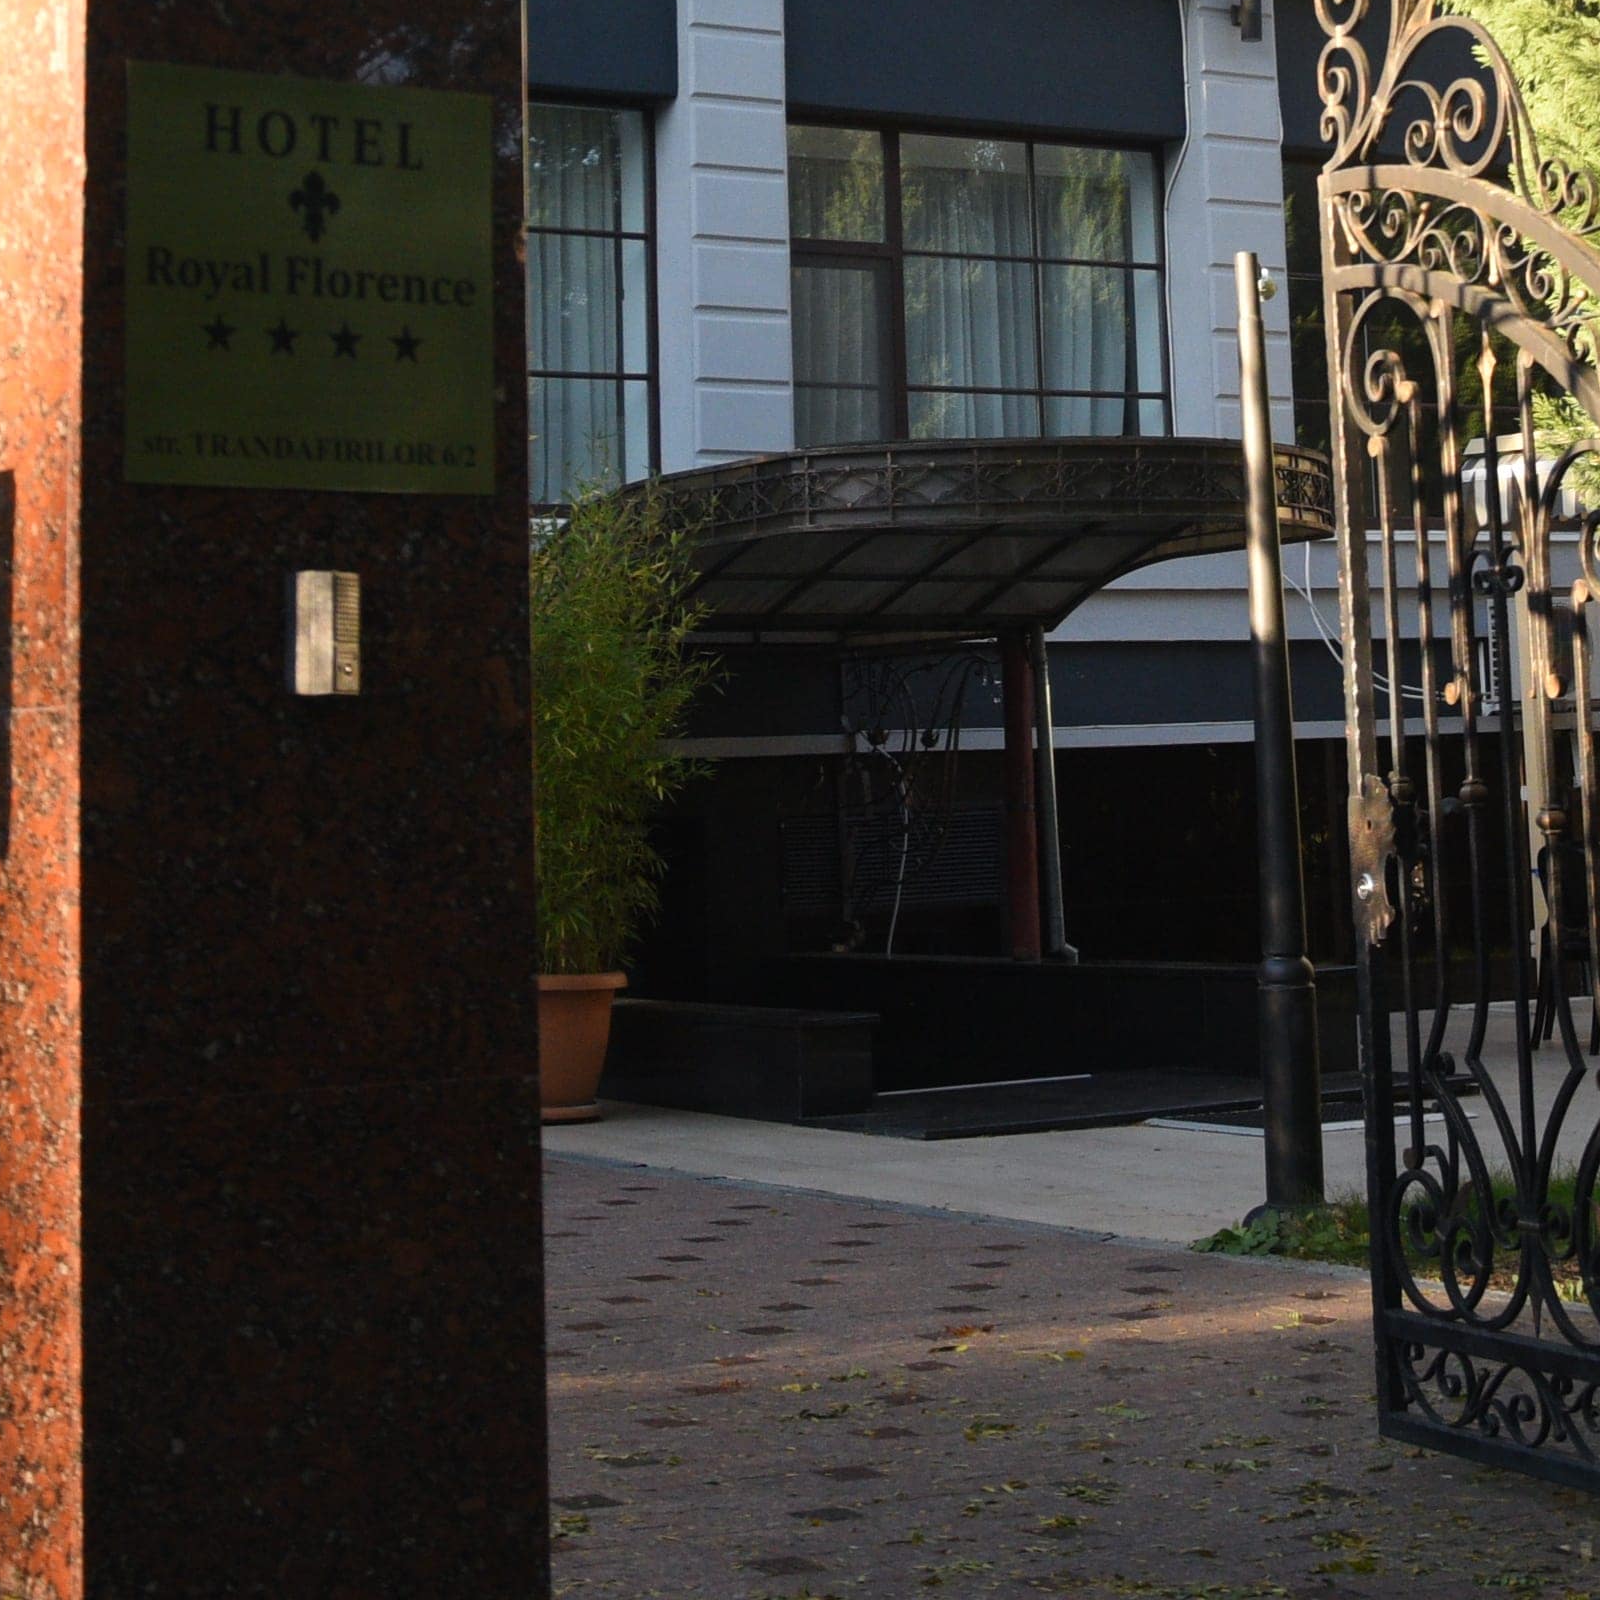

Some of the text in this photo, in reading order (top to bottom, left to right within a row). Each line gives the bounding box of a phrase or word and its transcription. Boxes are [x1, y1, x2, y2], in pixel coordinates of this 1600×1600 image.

[204, 103, 423, 171] HOTEL
[147, 246, 476, 307] Royal Florence
[194, 433, 436, 467] TRANDAFIRILOR
